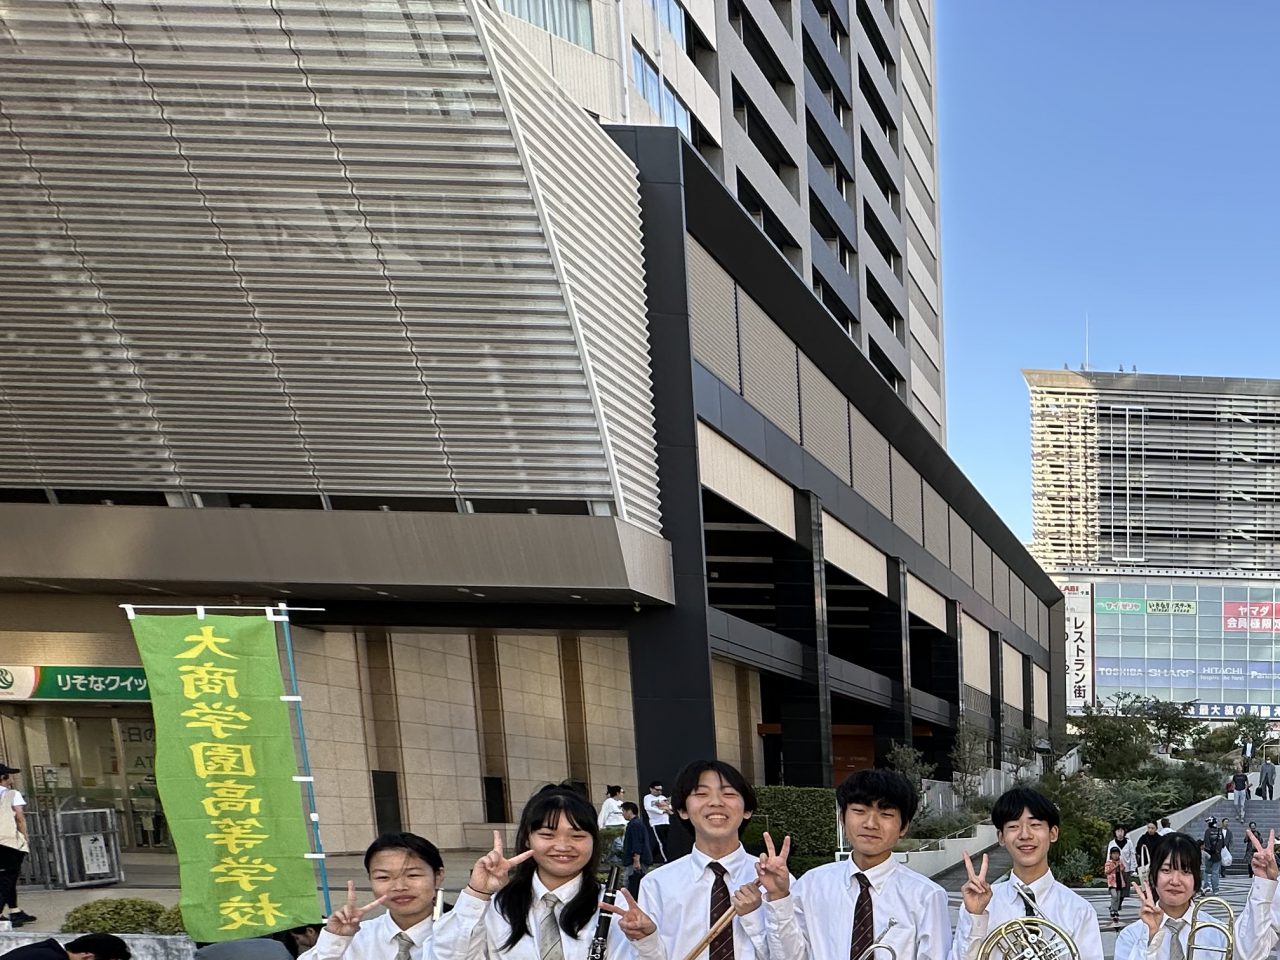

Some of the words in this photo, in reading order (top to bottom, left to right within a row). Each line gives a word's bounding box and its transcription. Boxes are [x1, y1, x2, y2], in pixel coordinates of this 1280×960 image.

[1238, 605, 1270, 616] ヤマダ
[1073, 616, 1087, 699] レストラン街
[1098, 667, 1144, 676] TOSHIBA
[1149, 668, 1195, 677] SHARP
[1202, 667, 1243, 675] HITACHI
